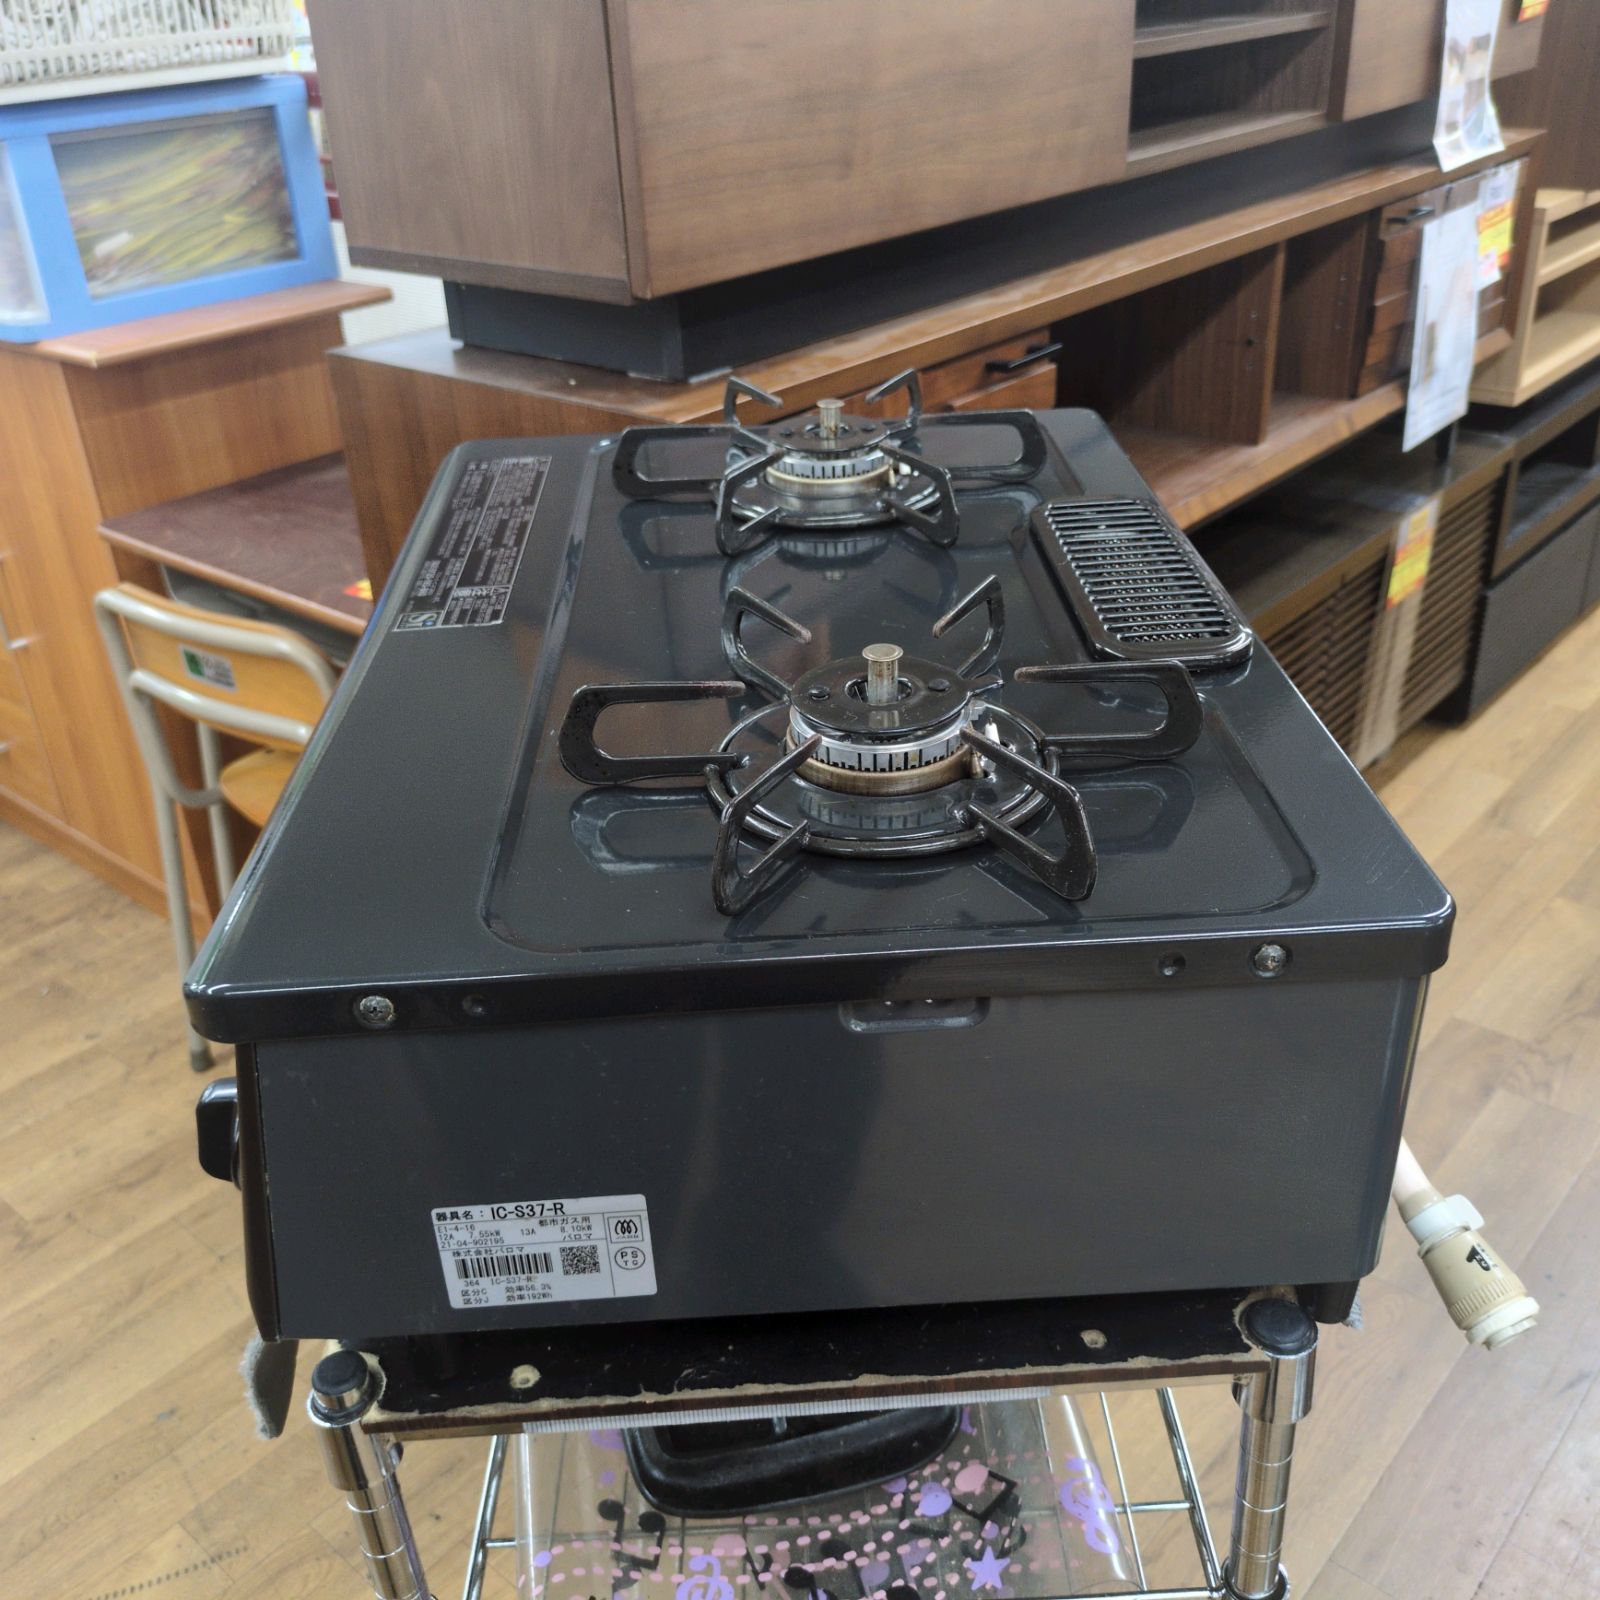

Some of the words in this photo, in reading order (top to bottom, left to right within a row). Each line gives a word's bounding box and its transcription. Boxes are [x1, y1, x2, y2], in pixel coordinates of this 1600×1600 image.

[490, 1202, 565, 1220] IC-S37-R
[520, 1228, 536, 1236] 13A
[464, 1279, 480, 1287] 364
[491, 1275, 532, 1285] IC-S37-R
